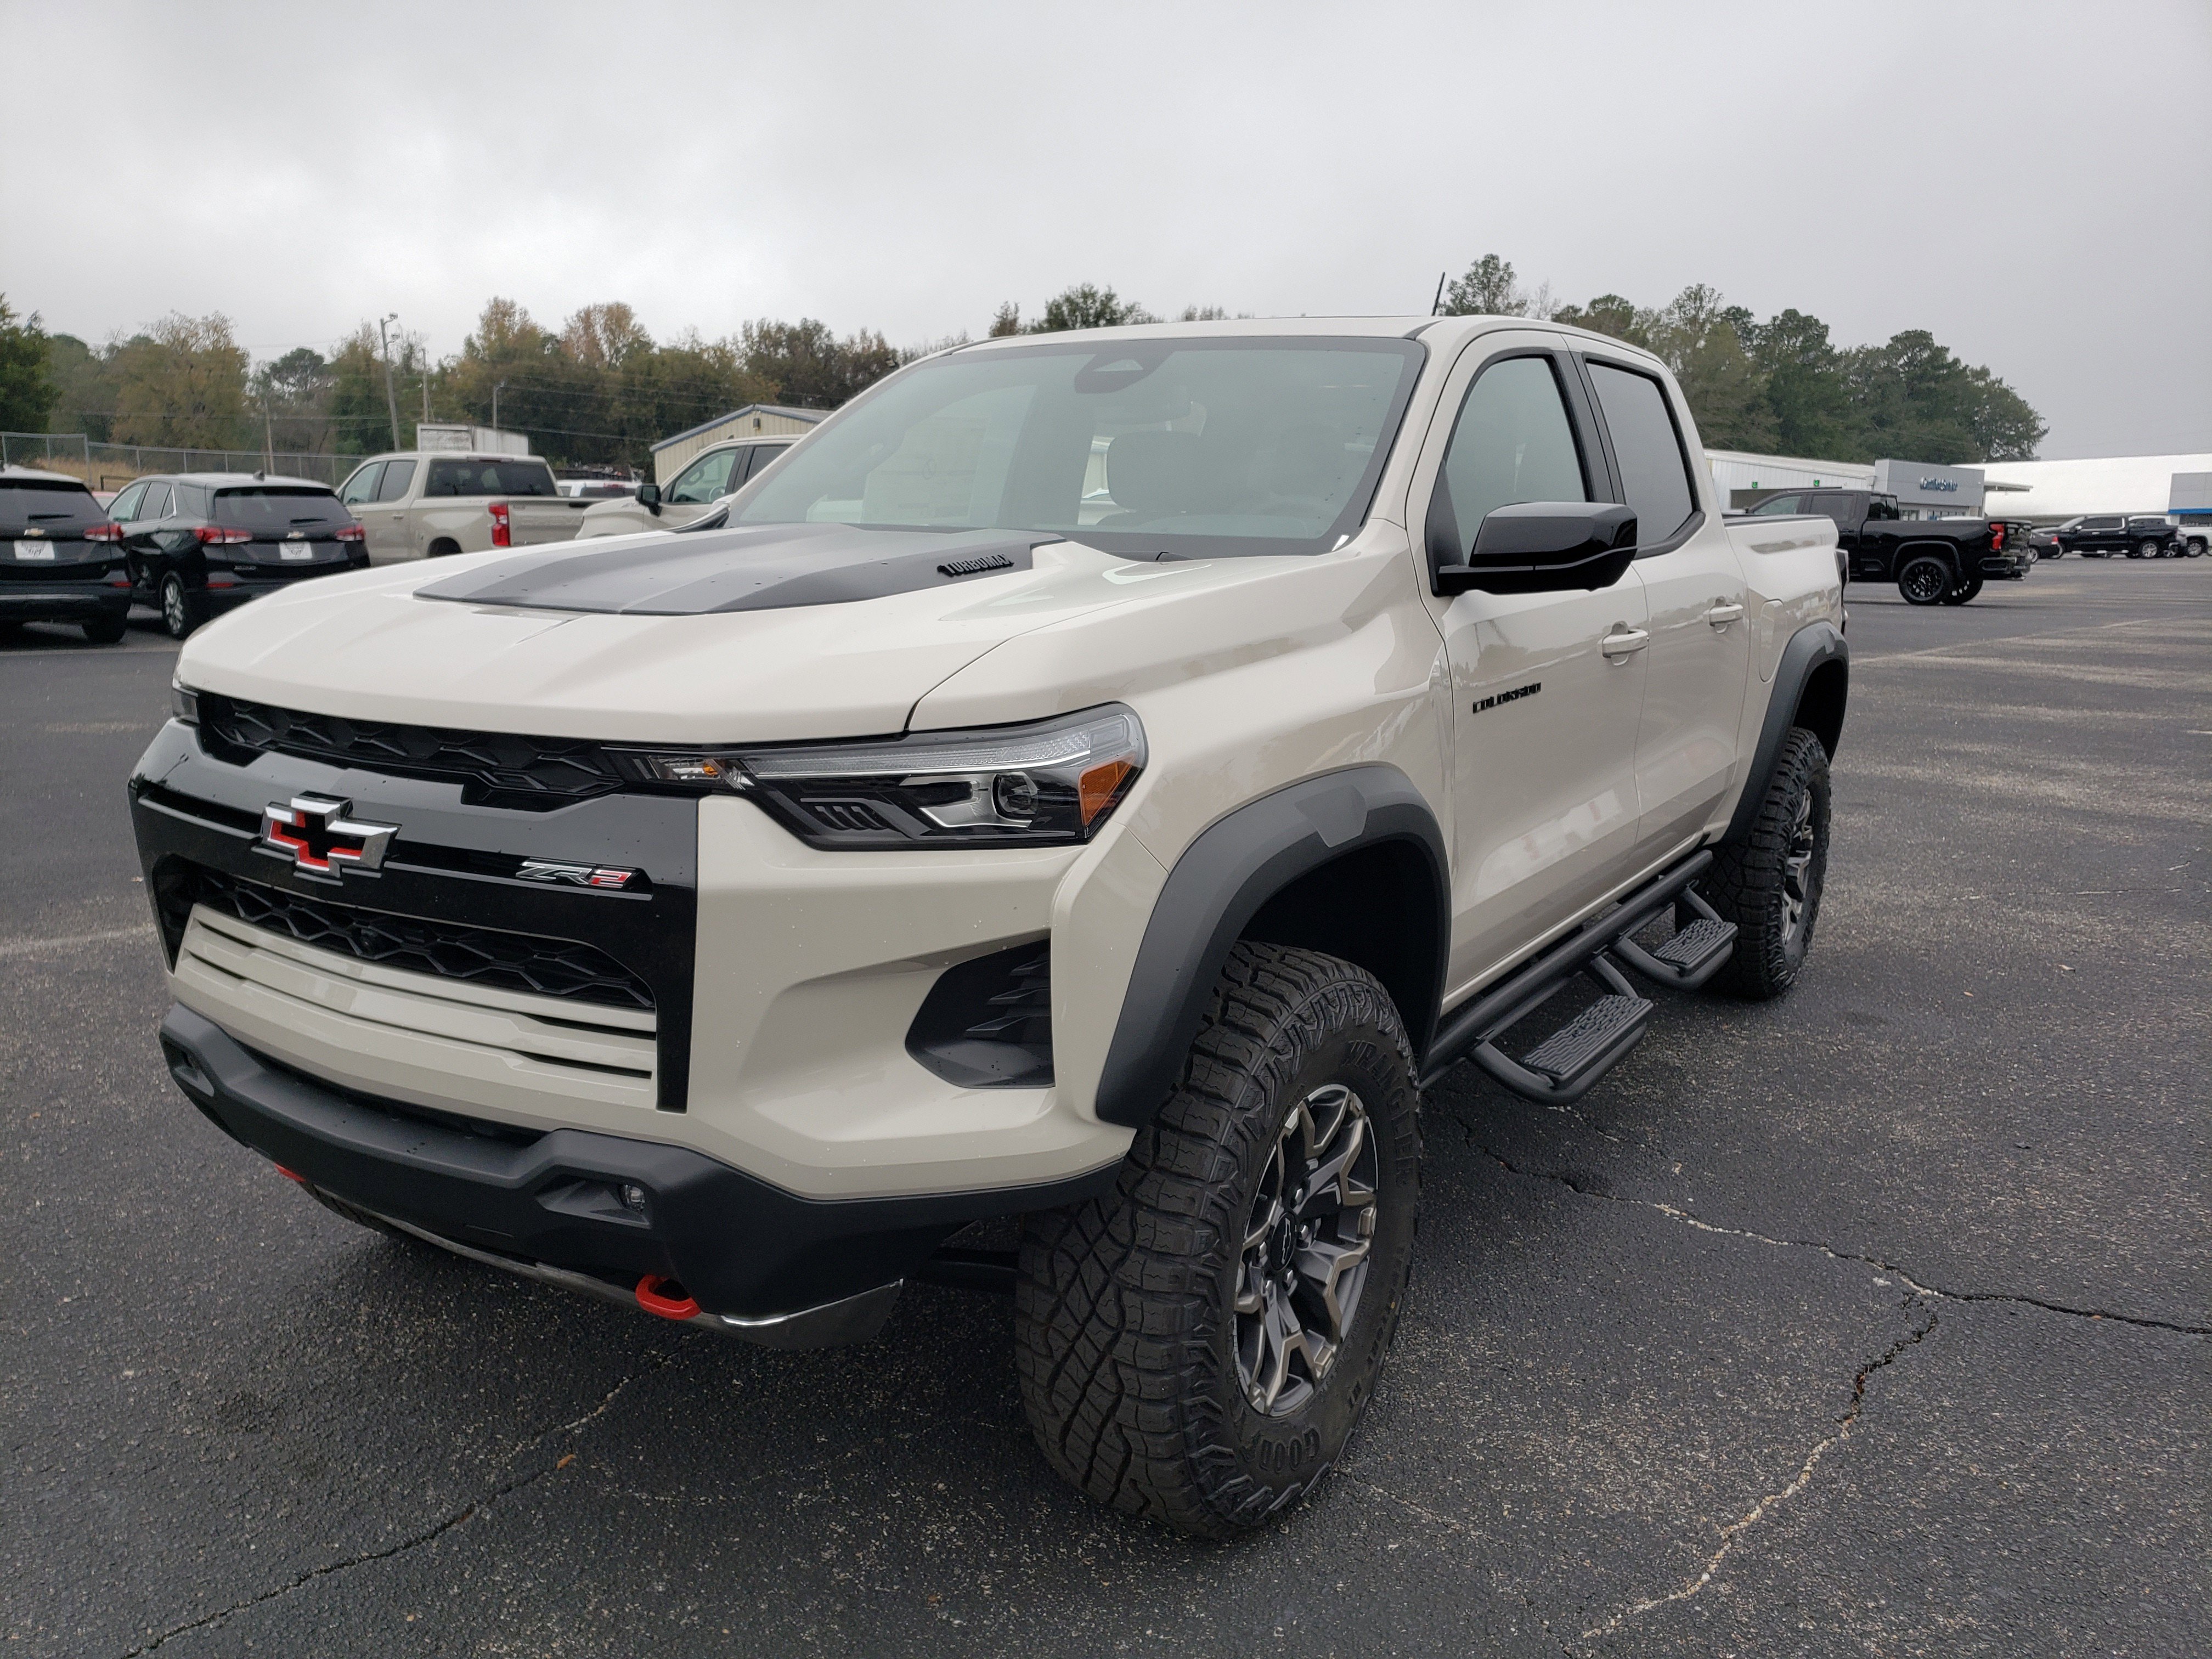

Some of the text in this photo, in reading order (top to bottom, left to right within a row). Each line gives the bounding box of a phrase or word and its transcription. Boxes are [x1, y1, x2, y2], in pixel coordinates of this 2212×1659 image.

[940, 554, 1014, 576] TURBOMAX
[1472, 681, 1542, 714] COLORADO
[515, 861, 633, 889] ZR2
[1341, 1040, 1415, 1186] WRANGLER
